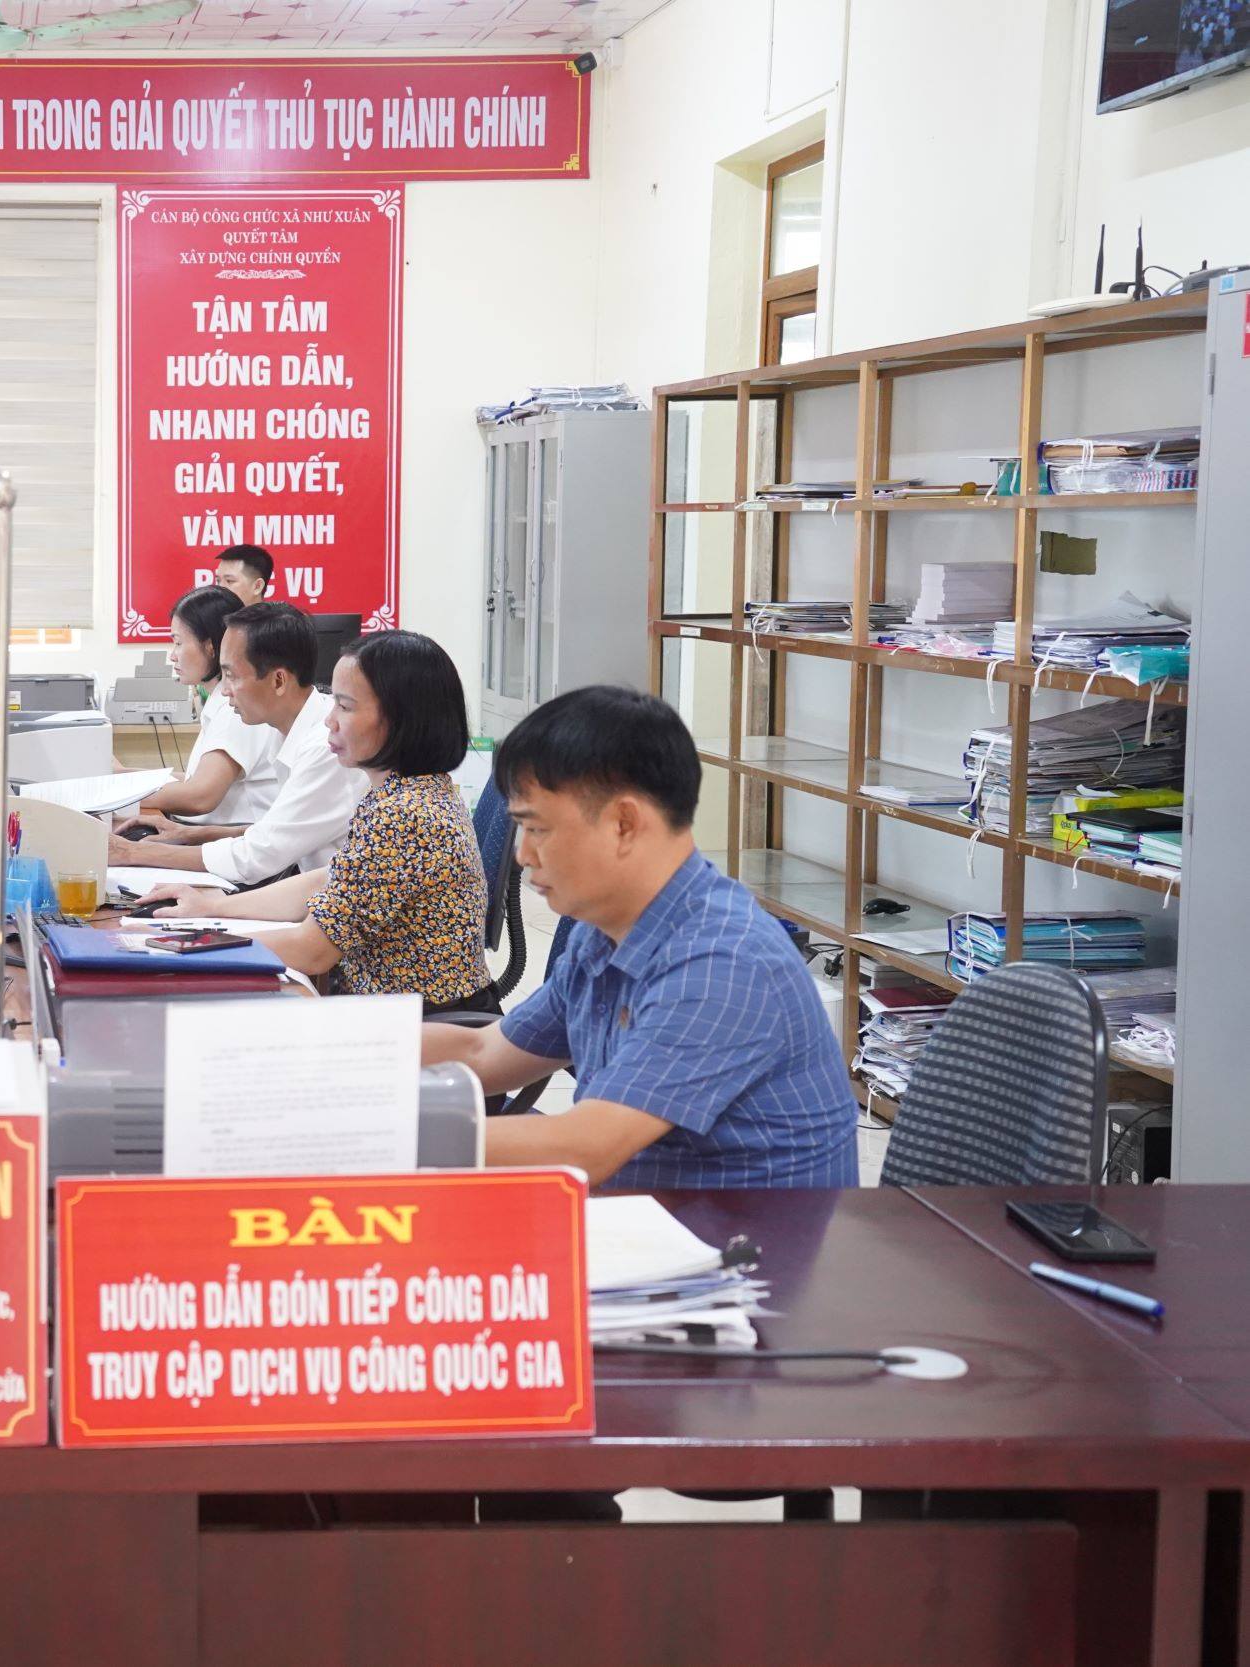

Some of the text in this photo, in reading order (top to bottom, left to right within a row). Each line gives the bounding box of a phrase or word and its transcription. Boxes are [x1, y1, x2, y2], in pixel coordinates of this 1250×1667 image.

[12, 99, 101, 150] TRONG
[111, 80, 163, 150] GIẢI
[173, 82, 257, 157] QUYẾT
[266, 79, 315, 150] THỦ
[324, 99, 373, 161] TỤC
[383, 87, 455, 148] HÀNH
[464, 86, 546, 148] CHÍNH
[151, 208, 370, 226] CÁN BỘ CÔNG CHỨC XÃ NHƯ XUÂN
[223, 228, 297, 245] QUYẾT TÂM
[180, 249, 205, 264] XÂY
[209, 251, 246, 266] DỰNG
[250, 250, 292, 264] CHÍNH
[192, 295, 327, 339] TẬN TÂM
[167, 343, 353, 389] HƯỚNG DẪN,
[150, 402, 369, 440] NHANH CHÓNG
[175, 452, 343, 496] GIẢI QUYẾT,
[183, 510, 334, 546] VĂN MINH
[285, 567, 323, 604] VỤ
[231, 1197, 418, 1246] BÀN
[99, 1263, 548, 1330] HƯỚNG DẪN ĐÓN TIẾP CÔNG DÂN
[88, 1328, 563, 1408] TRUY CẬP DỊCH VỤ CÔNG QUỐC GIA
